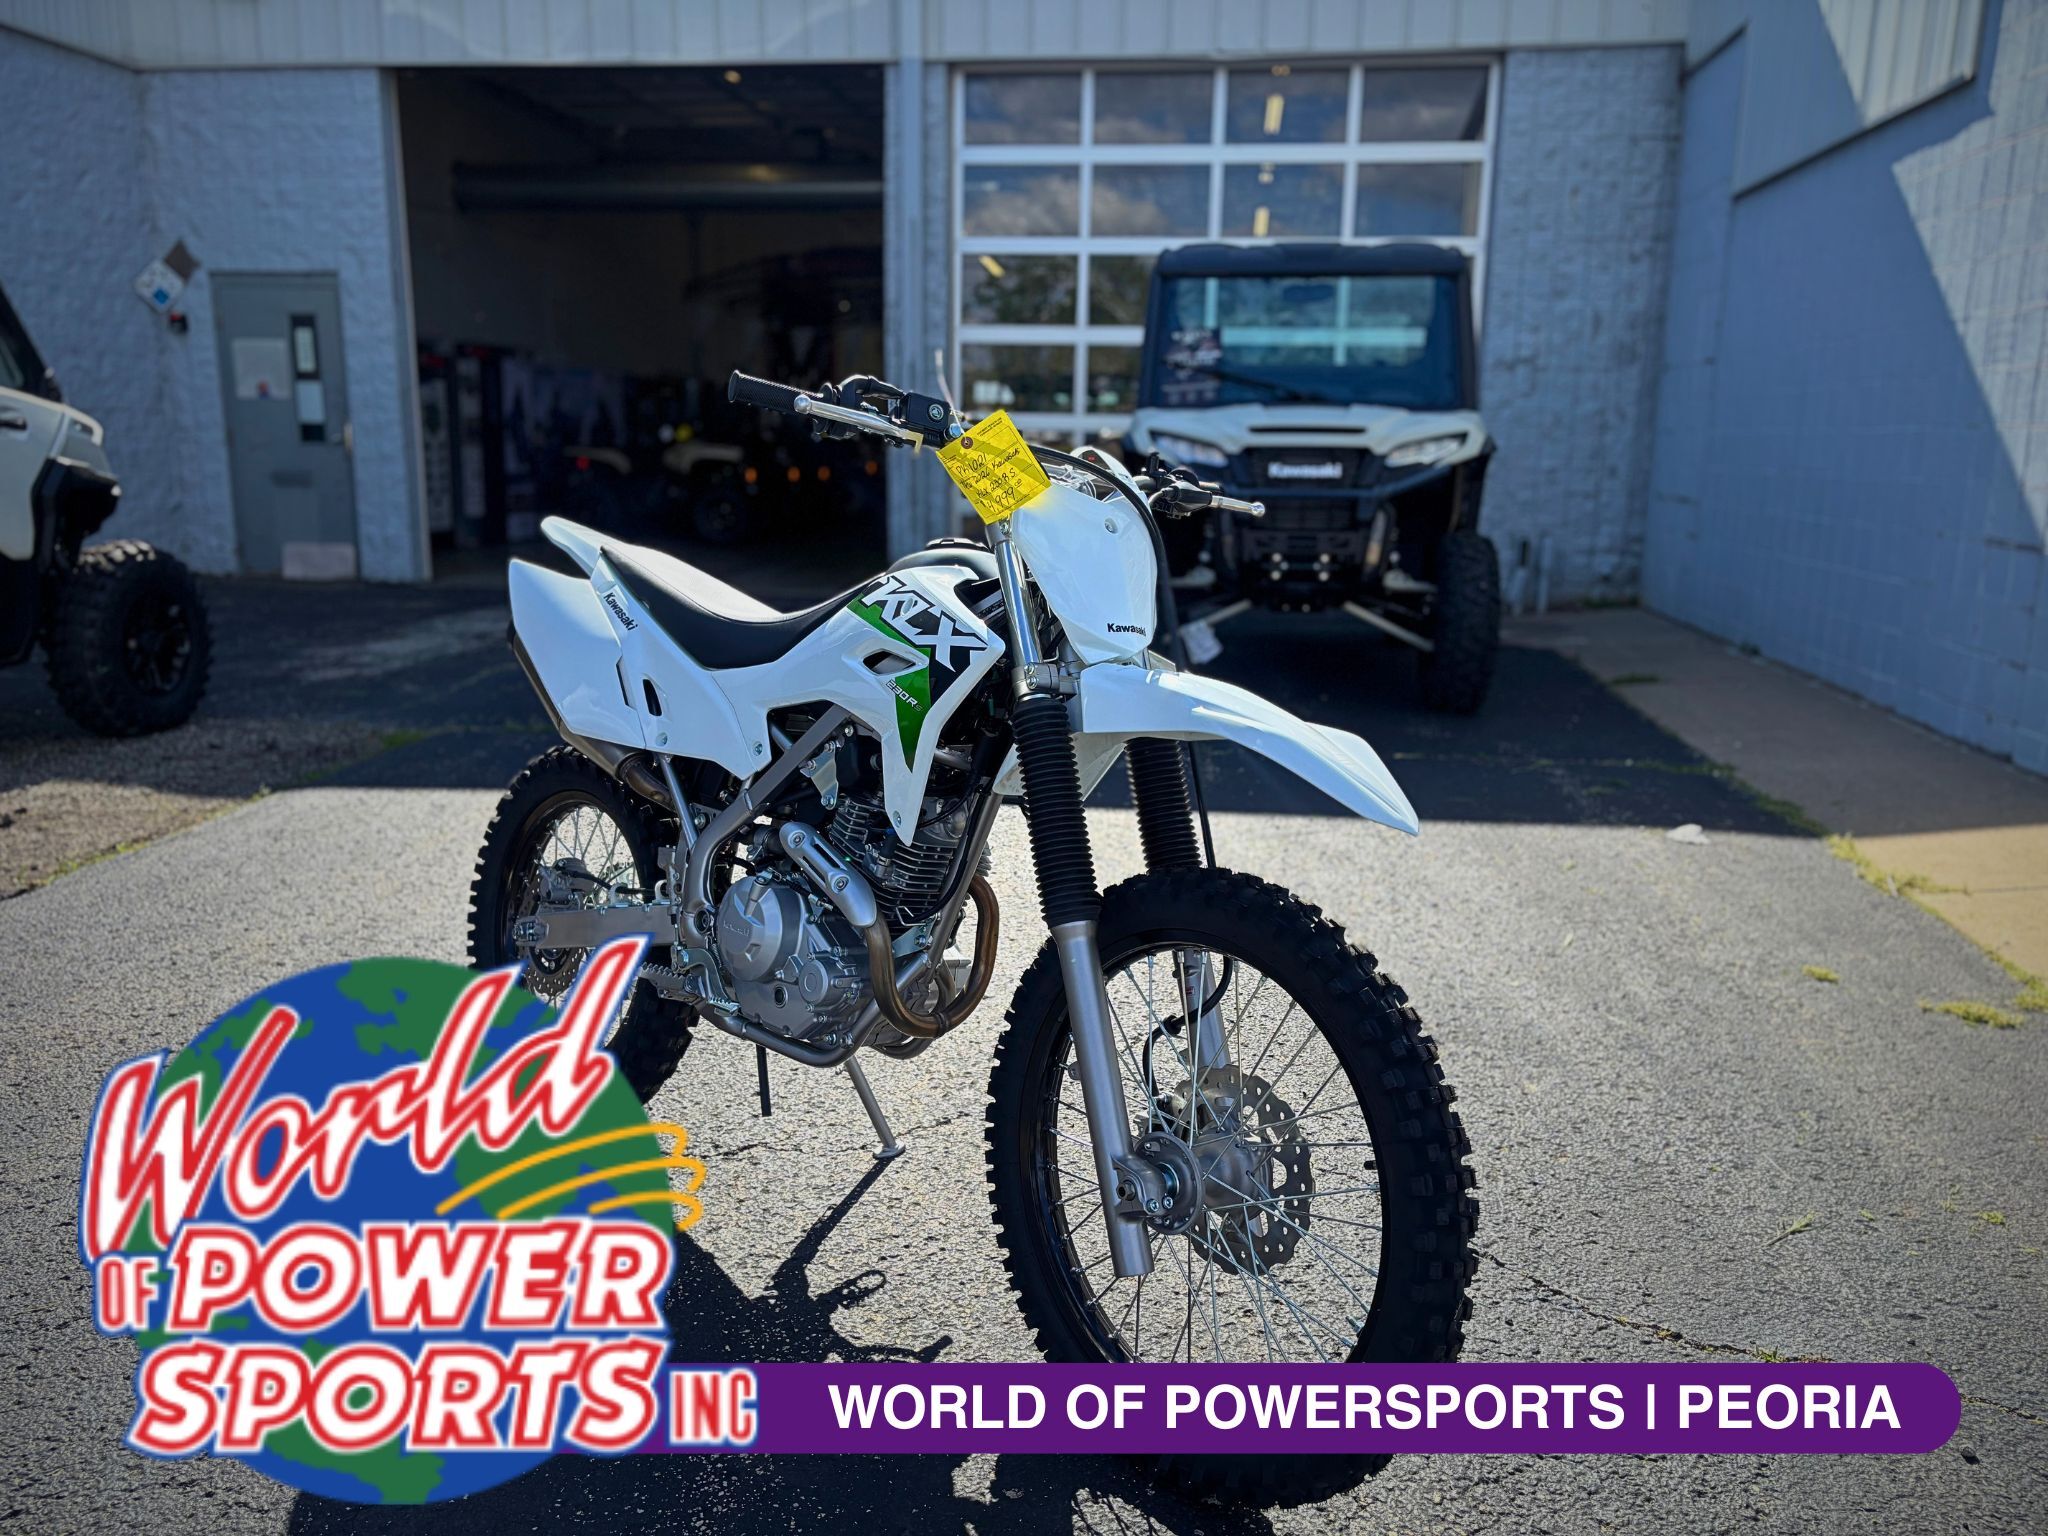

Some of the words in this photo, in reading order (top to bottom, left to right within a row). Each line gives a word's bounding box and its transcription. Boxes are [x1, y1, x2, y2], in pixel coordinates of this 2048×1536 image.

[603, 592, 638, 631] Kawasaki
[861, 575, 989, 673] KLX
[1107, 623, 1146, 637] Kawasaki
